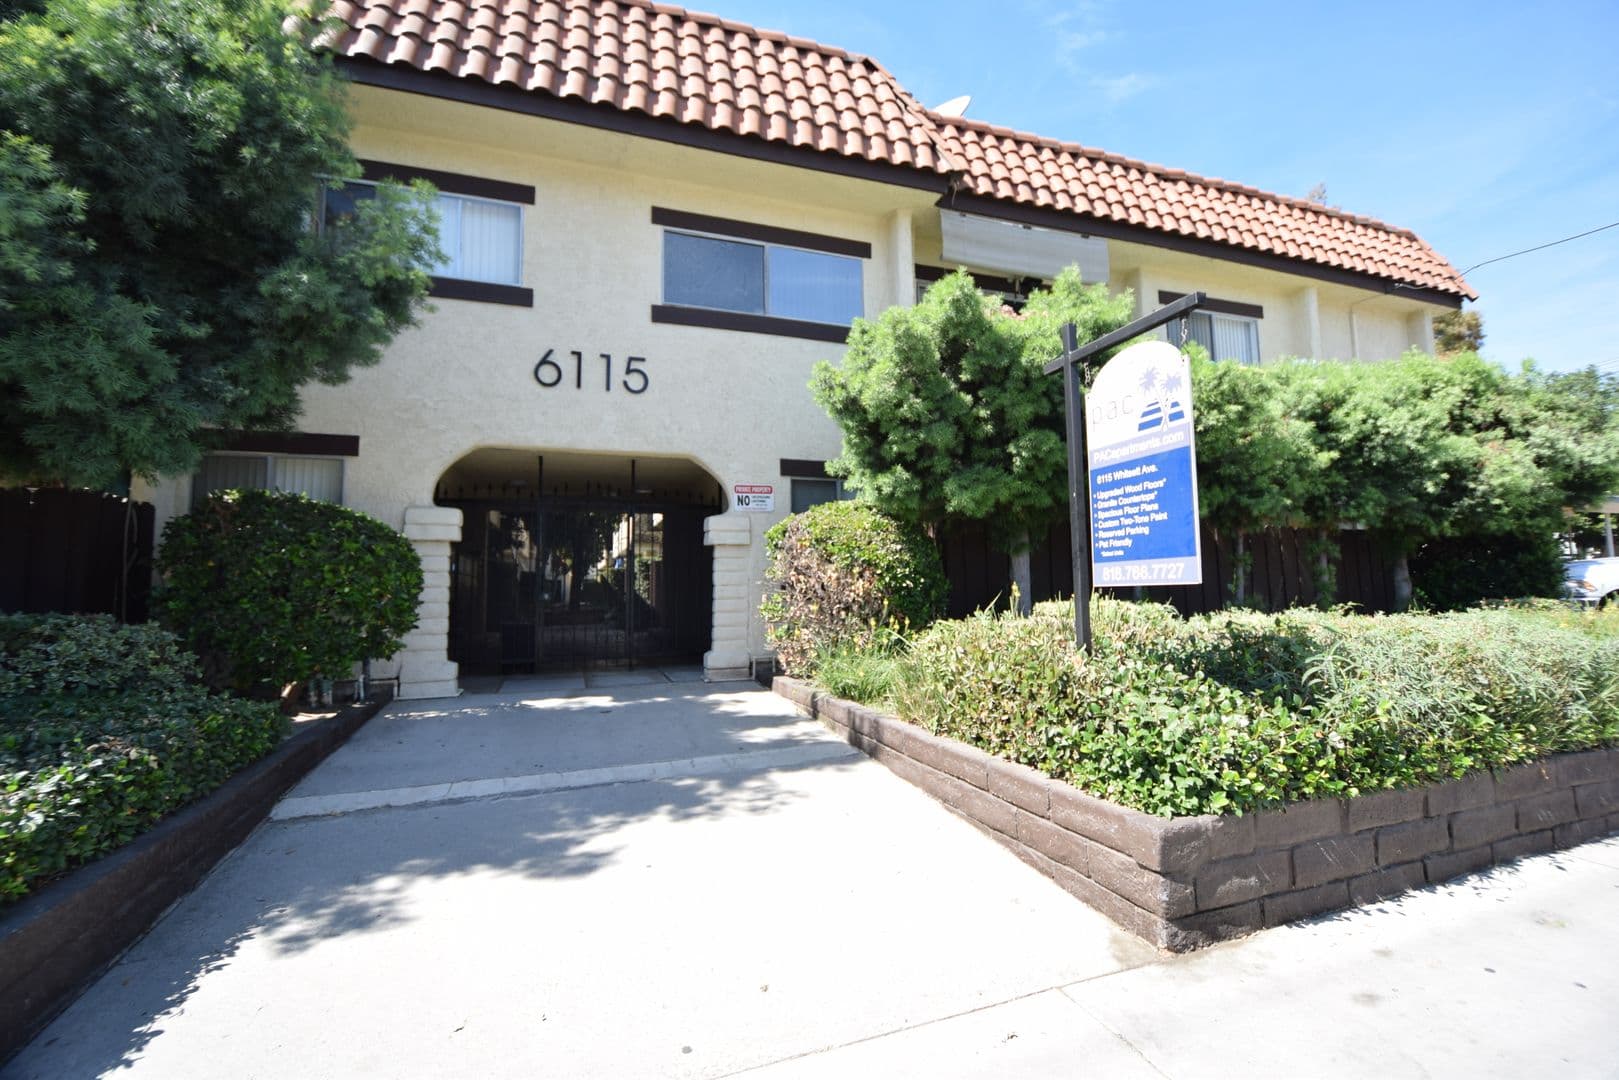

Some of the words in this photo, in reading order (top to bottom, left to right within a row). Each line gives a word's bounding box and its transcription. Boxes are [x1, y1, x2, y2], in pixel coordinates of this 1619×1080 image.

[534, 349, 649, 394] 6115
[1093, 395, 1133, 432] pac
[1097, 487, 1125, 500] Upgraded
[1125, 483, 1143, 494] Wood
[737, 495, 750, 506] NO
[1097, 498, 1118, 509] Granite
[1124, 506, 1140, 515] Floor
[1141, 503, 1159, 512] Plans
[1098, 519, 1120, 529] Custom
[1150, 512, 1168, 522] Paint
[1098, 529, 1125, 538] Reserved
[1126, 526, 1149, 535] Parking
[1098, 540, 1109, 548] Pet
[1109, 538, 1132, 547] Friendly
